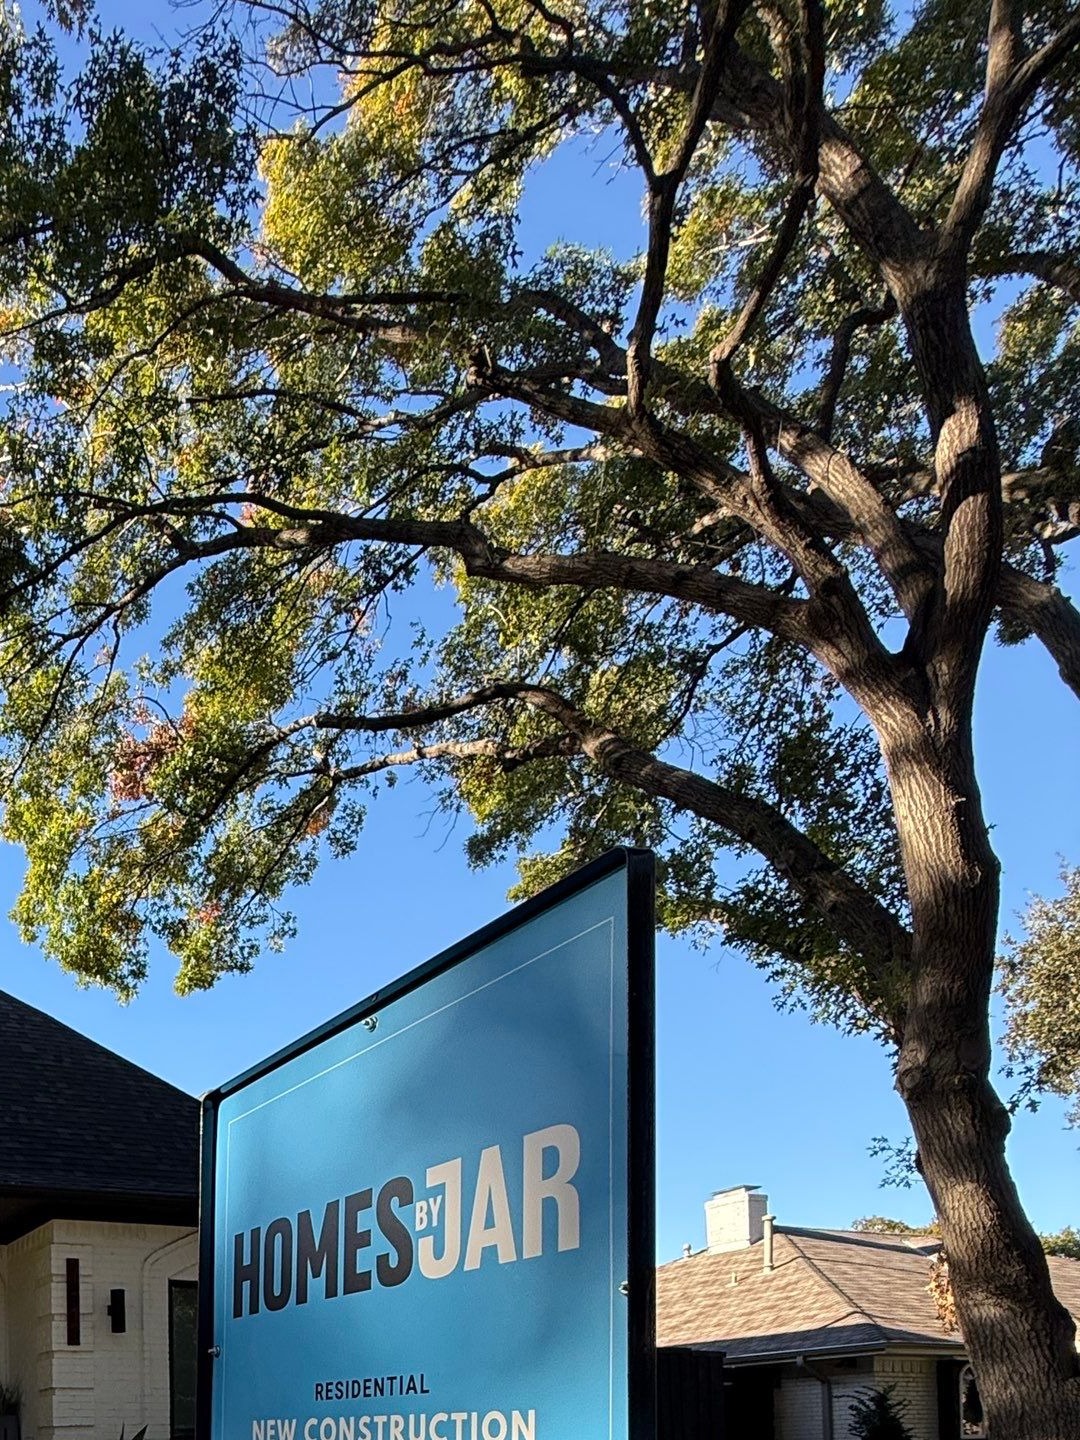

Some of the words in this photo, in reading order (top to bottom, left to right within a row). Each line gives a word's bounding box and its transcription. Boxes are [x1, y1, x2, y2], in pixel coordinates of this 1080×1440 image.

[416, 1196, 442, 1231] BY
[419, 1124, 580, 1278] JAR
[233, 1177, 414, 1318] HOMES
[315, 1374, 430, 1401] RESIDENTIAL
